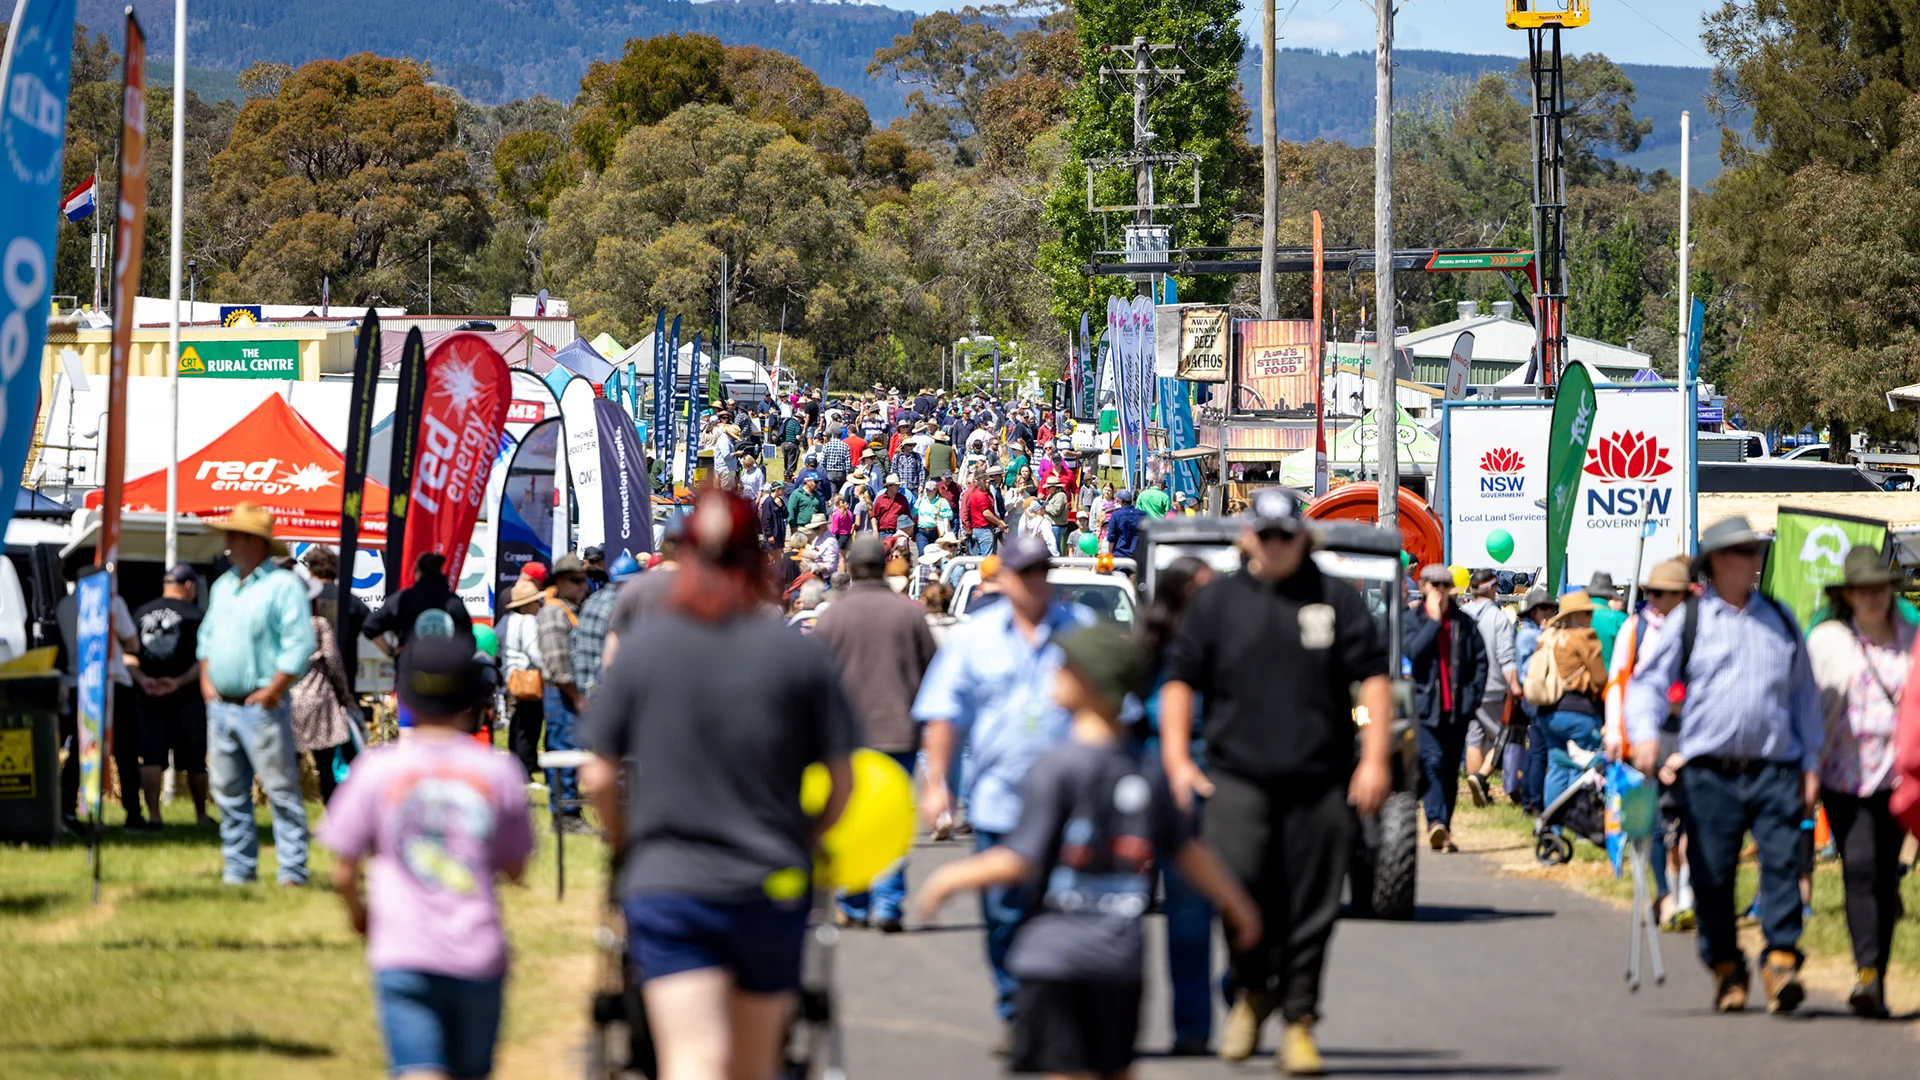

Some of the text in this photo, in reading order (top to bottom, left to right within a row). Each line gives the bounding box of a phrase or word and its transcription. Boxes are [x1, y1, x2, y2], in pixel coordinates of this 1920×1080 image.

[1191, 318, 1219, 326] AWARD
[1188, 326, 1222, 334] WINNING
[1194, 335, 1215, 349] BEEF
[242, 348, 259, 358] THE
[181, 358, 197, 368] CRT
[208, 358, 294, 372] RURAL CENTRE
[1185, 353, 1223, 369] NACHOS
[1257, 356, 1304, 367] STREET
[1264, 365, 1297, 375] FOOD
[195, 458, 278, 481] red
[412, 414, 459, 515] red
[447, 410, 488, 503] energy
[211, 480, 292, 496] energy
[1480, 476, 1525, 492] NSW
[619, 469, 631, 539] Connection
[1587, 487, 1673, 516] NSW
[1459, 513, 1547, 522] Local Land Services
[1587, 518, 1670, 529] GOVERNNT
